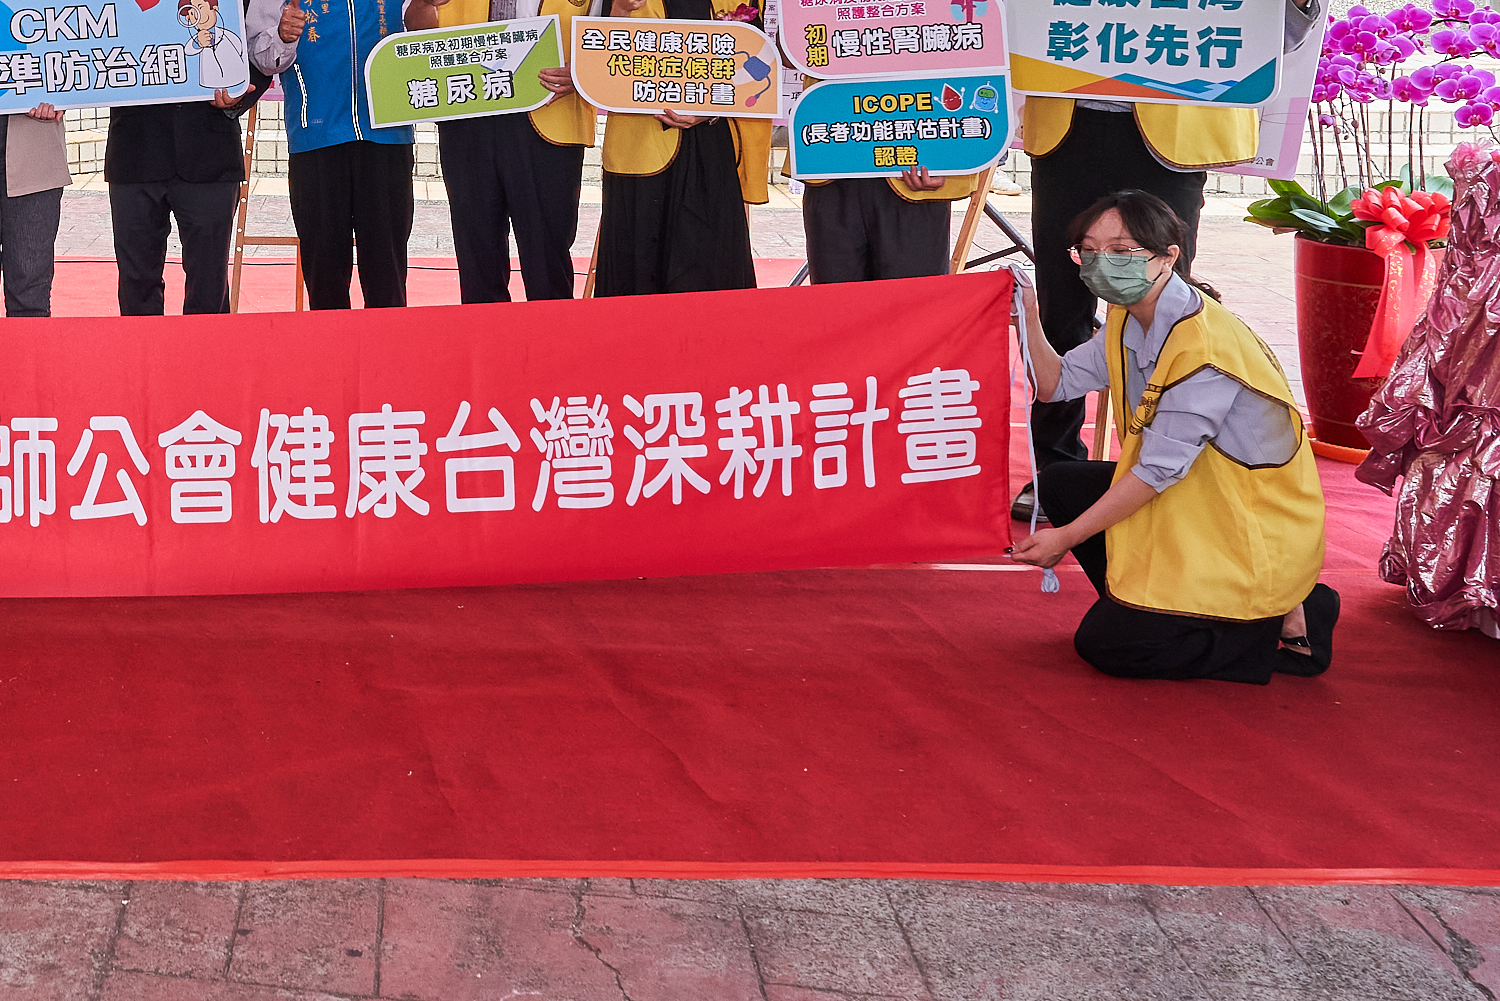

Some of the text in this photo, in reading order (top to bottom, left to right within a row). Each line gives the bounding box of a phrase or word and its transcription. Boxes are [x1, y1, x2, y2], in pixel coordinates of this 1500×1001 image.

[9, 3, 118, 44] CKM
[837, 2, 926, 22] 照護整合方案
[396, 29, 539, 57] 糖尿病及初期慢性腎臟病
[582, 29, 736, 56] 全民健康保險
[805, 24, 829, 67] 初期
[832, 23, 984, 58] 慢性腎臟病
[1046, 20, 1245, 70] 彰化先行
[430, 48, 508, 69] 照護整合方案
[607, 54, 735, 80] 代謝症候群
[407, 69, 515, 110] 糖尿病
[633, 81, 735, 105] 防治計畫
[853, 92, 933, 114] ICOPE
[801, 116, 991, 145] (長者功能評估計畫)
[873, 146, 918, 166] 認證
